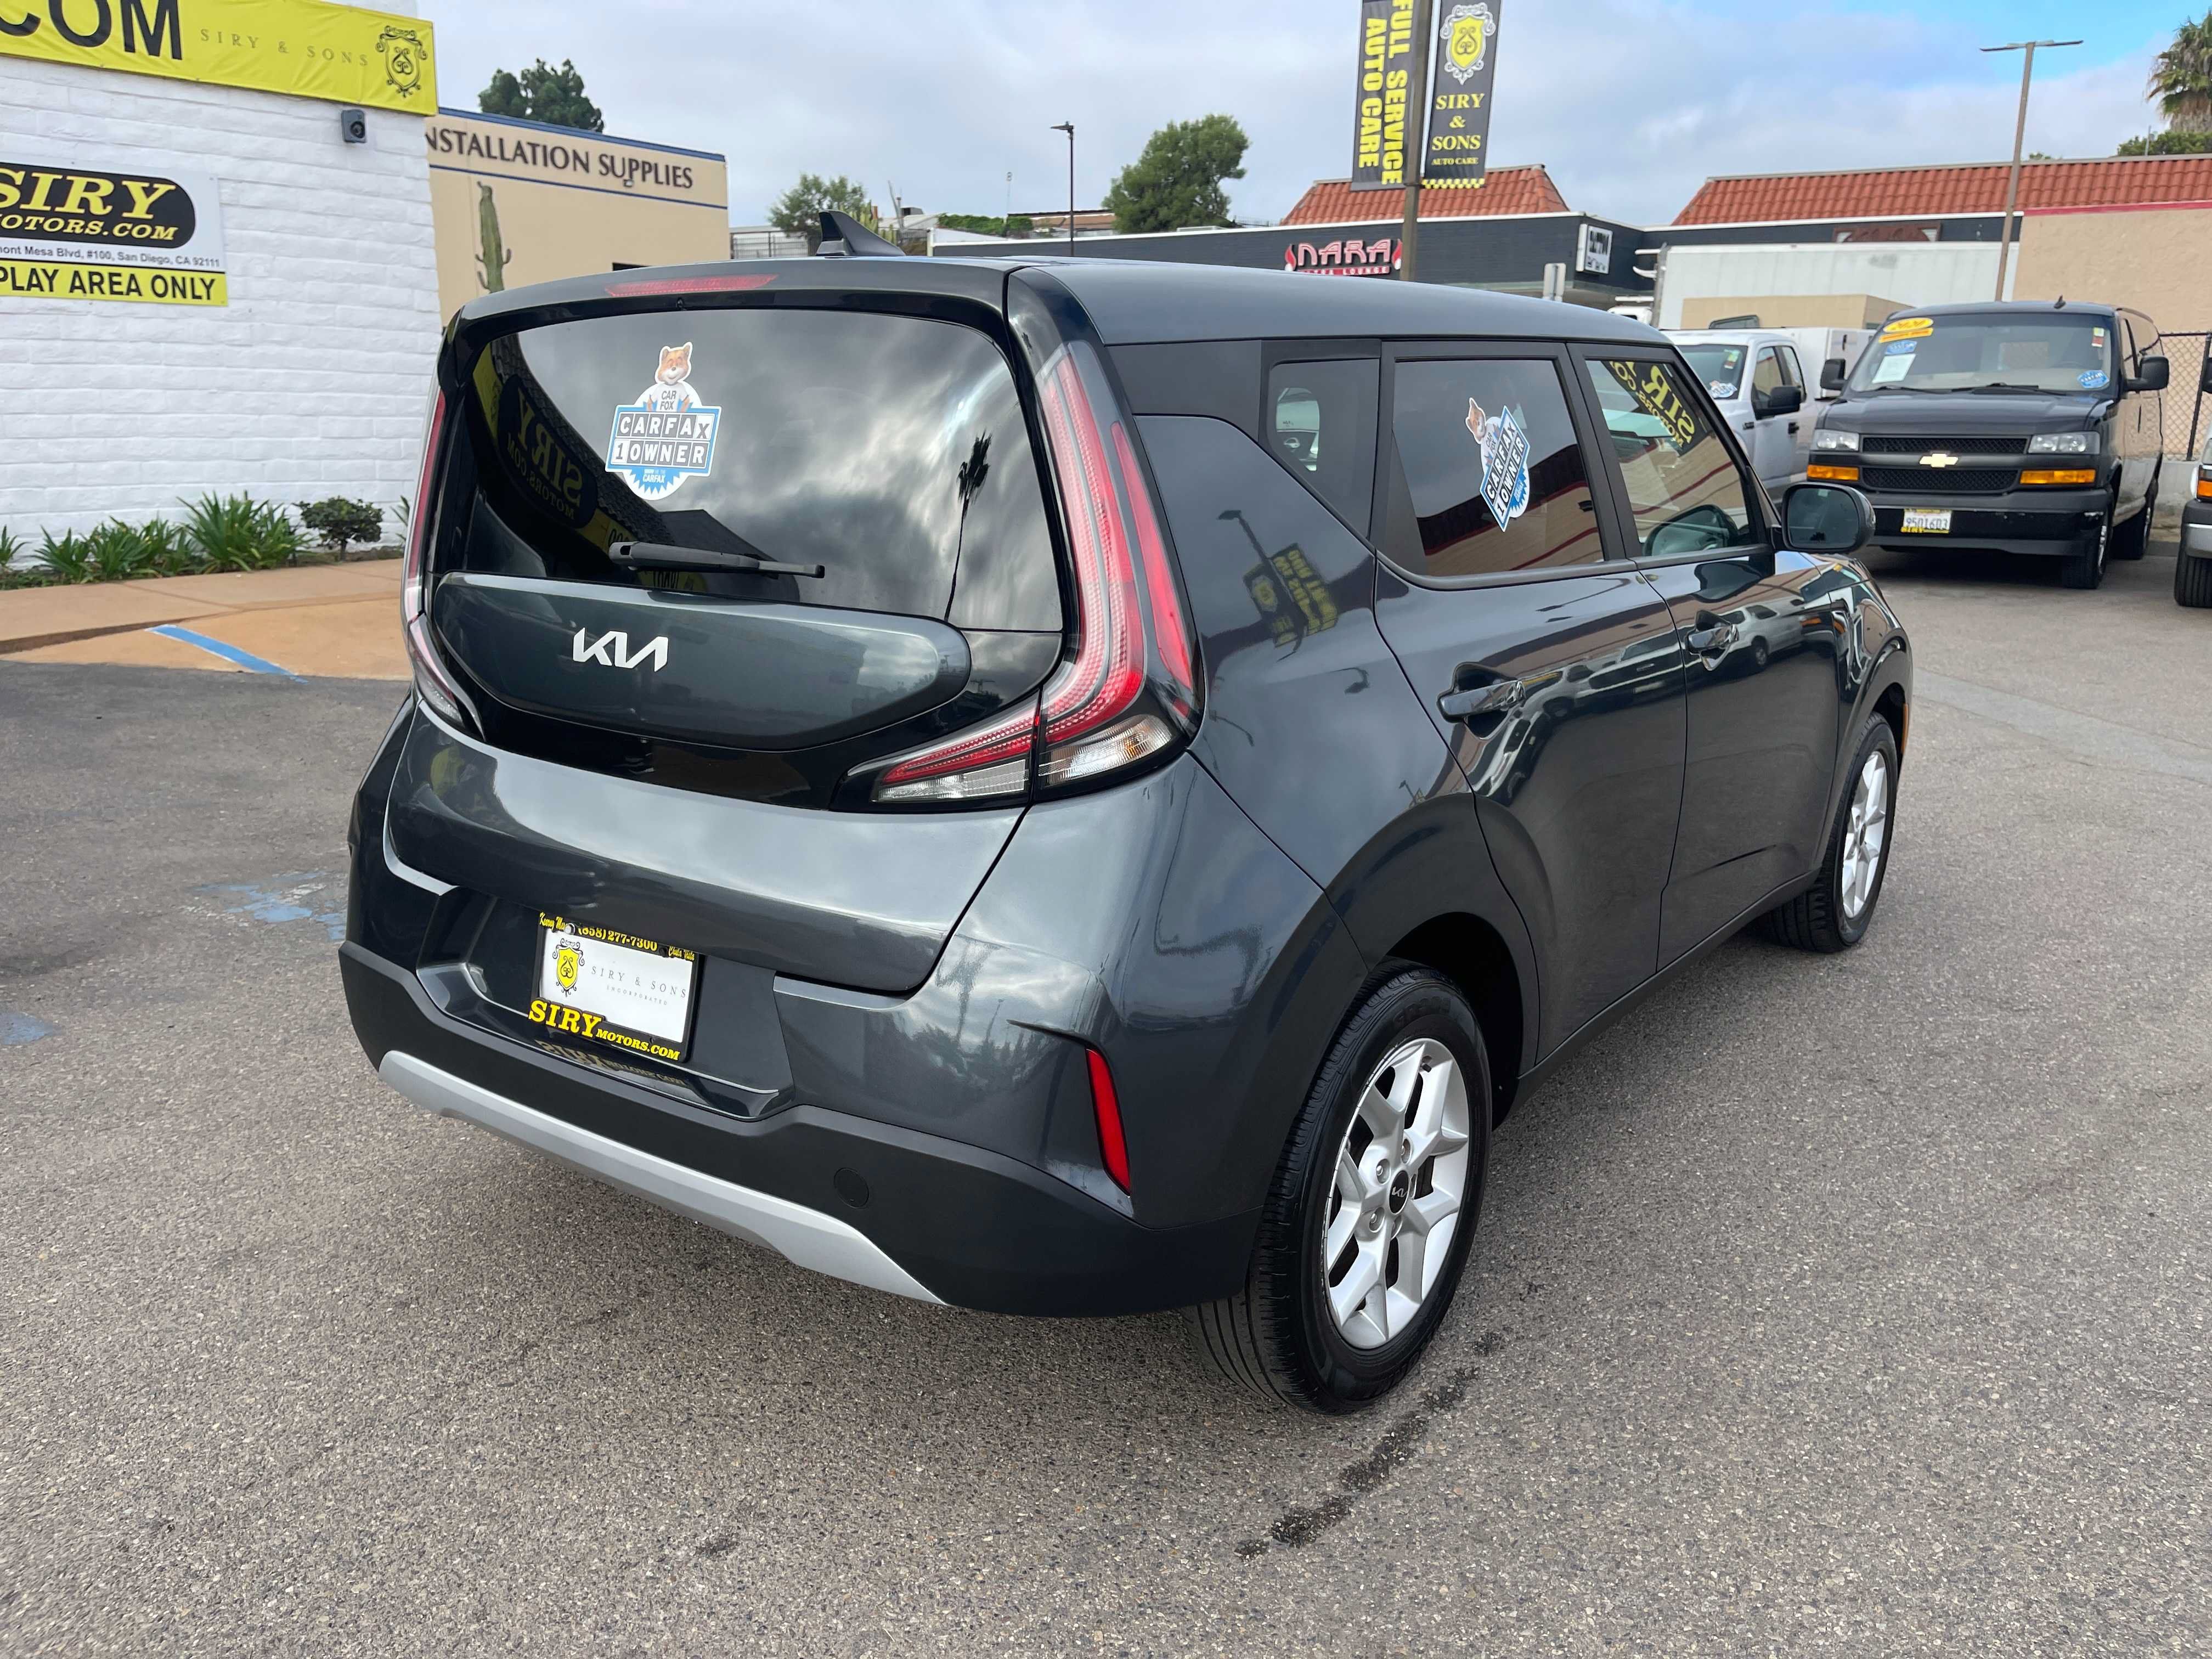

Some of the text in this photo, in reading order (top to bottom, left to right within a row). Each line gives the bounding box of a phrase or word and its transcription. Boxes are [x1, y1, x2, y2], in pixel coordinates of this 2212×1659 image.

[200, 29, 368, 66] SIRY & SONS
[1358, 18, 1387, 168] AUTO CARE
[1381, 0, 1413, 184] FULL SERVICE
[1436, 93, 1485, 110] SIRY
[1449, 115, 1466, 128] &
[1431, 135, 1481, 151] SONS
[599, 154, 692, 188] SUPPLIES
[0, 167, 176, 219] SIRY
[0, 213, 179, 240] OTORS.COM
[0, 245, 219, 267] ont Mesa Blvd, #100, San Diego, CA 92111
[1343, 266, 1388, 275] LOUNGE
[69, 269, 143, 296] AREA
[151, 274, 215, 300] ONLY
[660, 400, 674, 410] FOX
[662, 390, 676, 400] CAR
[620, 416, 710, 439] CARFAX
[1486, 422, 1516, 500] CARFAX
[642, 473, 666, 483] CARFAX
[572, 627, 669, 672] KIA
[607, 930, 658, 951] 277-7300
[591, 966, 686, 998] SIRY & SONS
[607, 985, 668, 1006] INCORPORATED
[528, 1000, 680, 1060] SIRY MOTORS.COM
